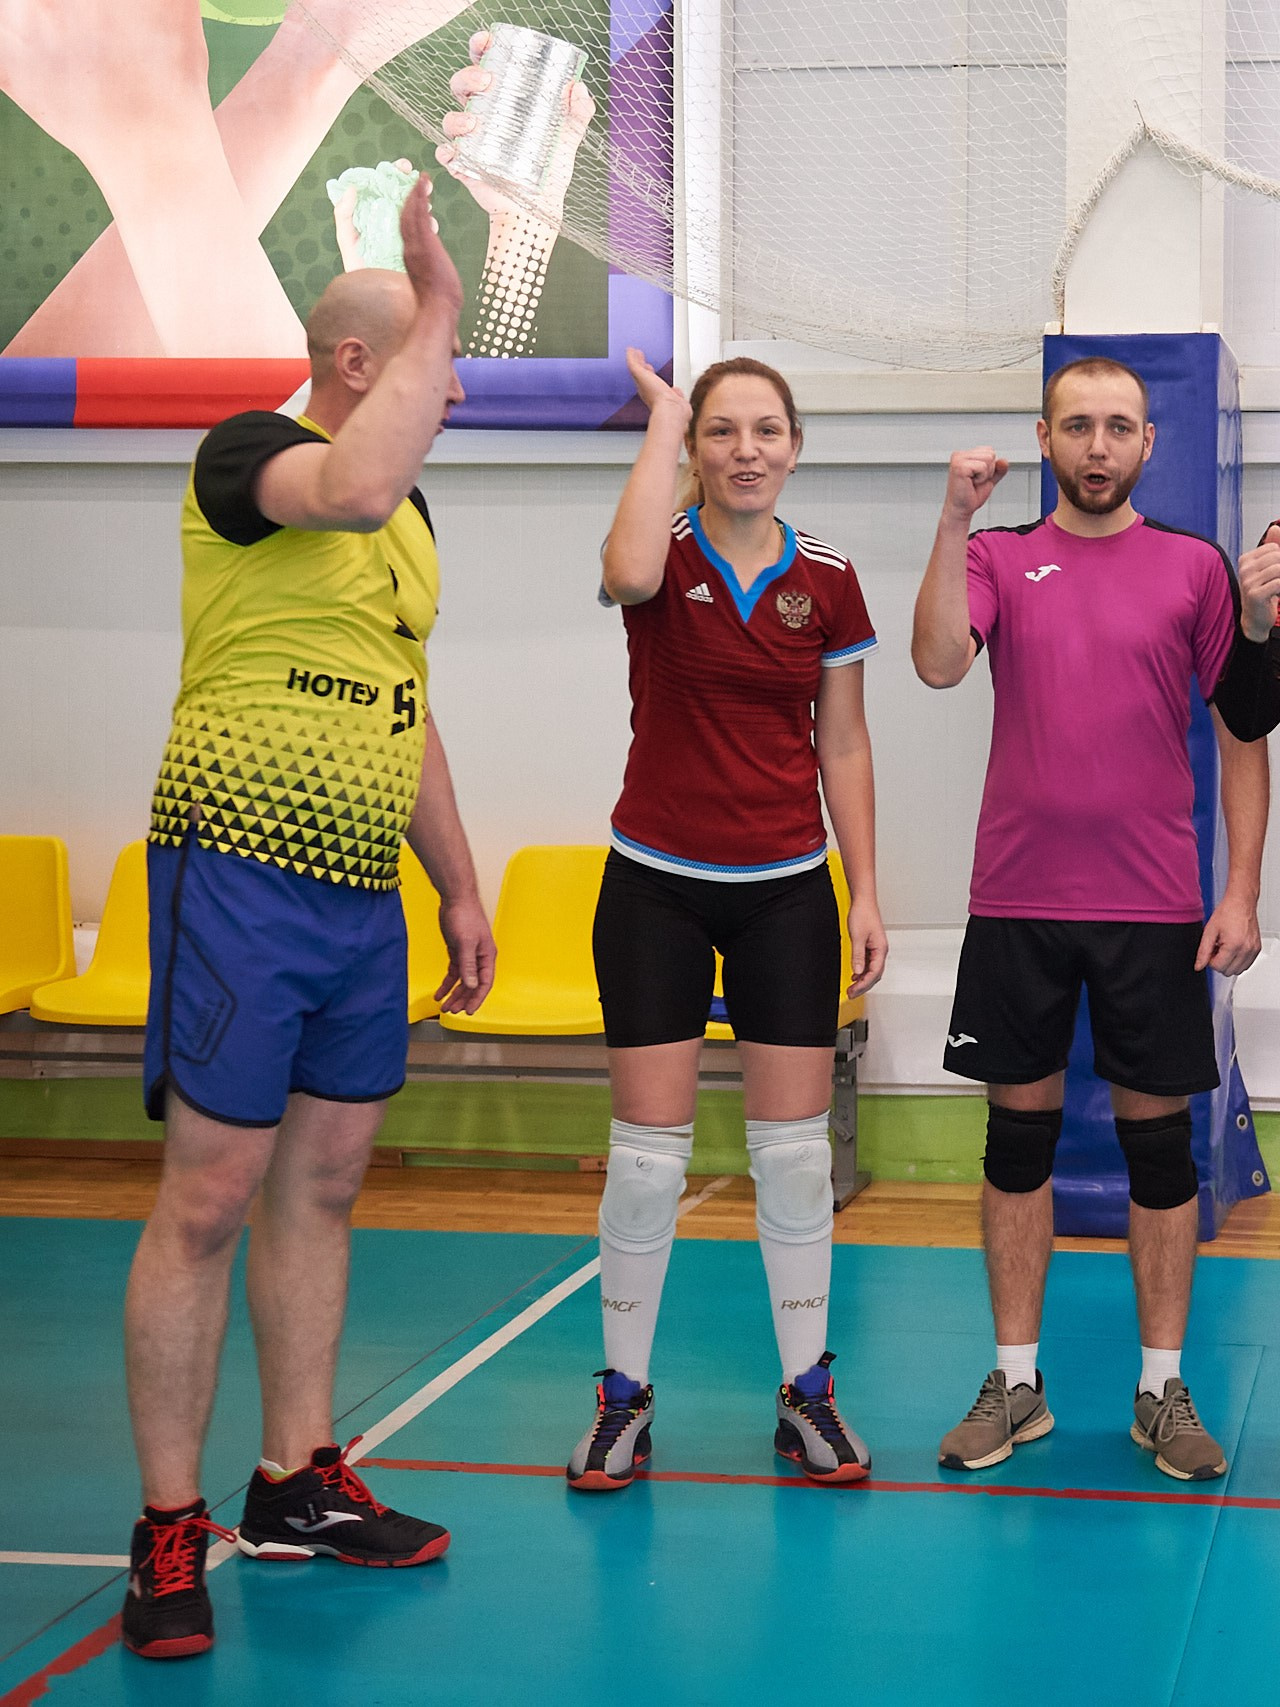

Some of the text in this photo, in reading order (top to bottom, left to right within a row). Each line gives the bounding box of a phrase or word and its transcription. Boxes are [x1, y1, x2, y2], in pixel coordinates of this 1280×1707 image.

[287, 667, 379, 707] HOTEY
[601, 1295, 641, 1312] MCF
[781, 1294, 828, 1310] RMCF
